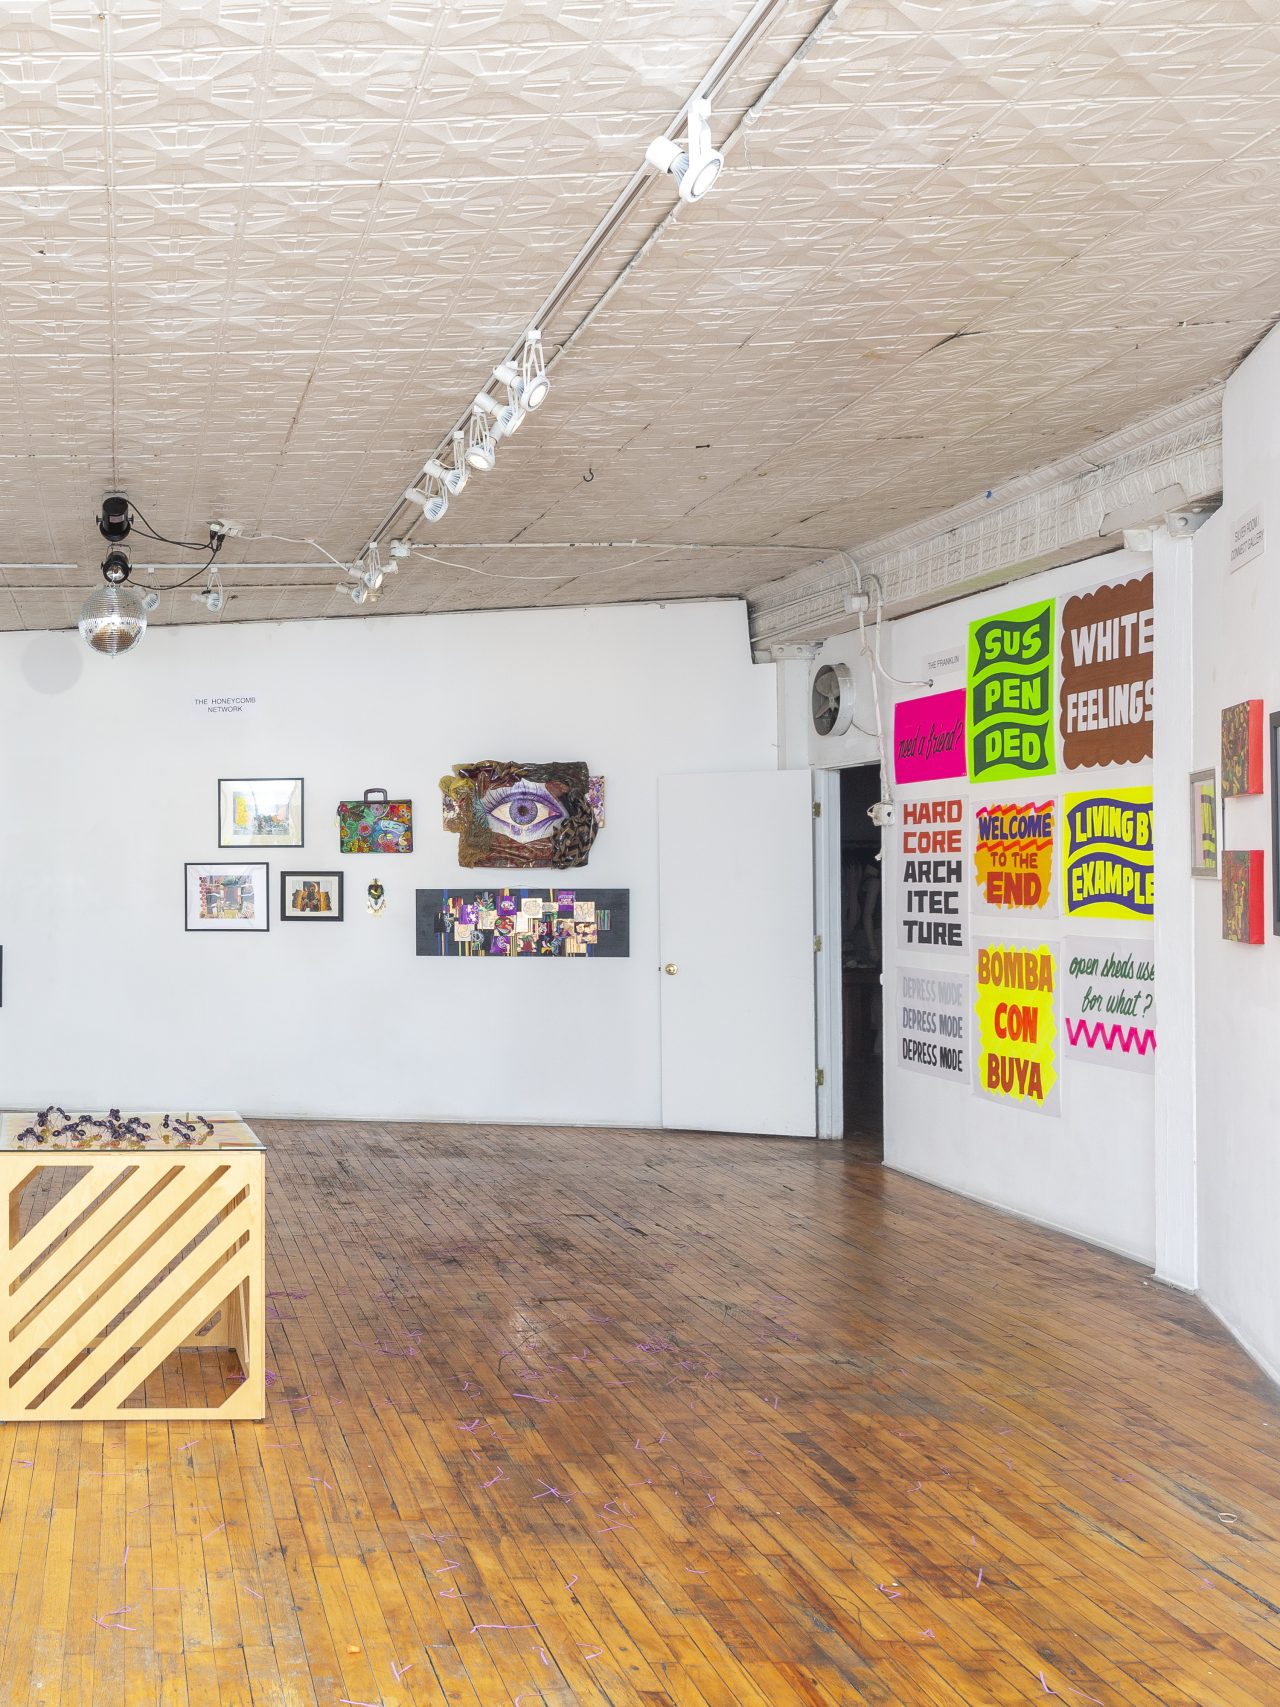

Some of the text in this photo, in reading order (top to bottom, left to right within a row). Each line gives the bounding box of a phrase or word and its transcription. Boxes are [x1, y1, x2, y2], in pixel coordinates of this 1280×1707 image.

[984, 623, 1042, 660] SUS
[1070, 608, 1154, 668] WHITE
[927, 655, 960, 670] THE FRANKLIN
[207, 705, 243, 713] NETWORK
[211, 697, 257, 705] HONEYCOMB
[985, 676, 1042, 713] PEN
[1066, 678, 1154, 734] FEELINGS
[898, 720, 964, 761] need a friend?
[985, 728, 1042, 764] DED
[903, 799, 963, 825] HARD
[978, 813, 1052, 841] WELCOME
[1075, 805, 1134, 843] LIVING
[903, 829, 962, 854] CORE
[903, 860, 963, 883] ARCH
[990, 851, 1038, 869] TO THE
[986, 871, 1042, 906] END
[1072, 860, 1154, 905] EXAMPLE
[907, 890, 959, 915] ITEC
[902, 919, 963, 947] TURE
[978, 948, 1053, 993] BOMBA
[1069, 957, 1099, 979] open
[1100, 951, 1135, 980] sheds
[903, 976, 963, 1007] DEPRESS MODE
[1081, 985, 1104, 1013] for
[902, 1006, 963, 1039] DEPRESS MODE
[994, 1002, 1038, 1044] CON
[902, 1037, 963, 1072] DEPRESS MODE
[987, 1053, 1044, 1100] BUYA
